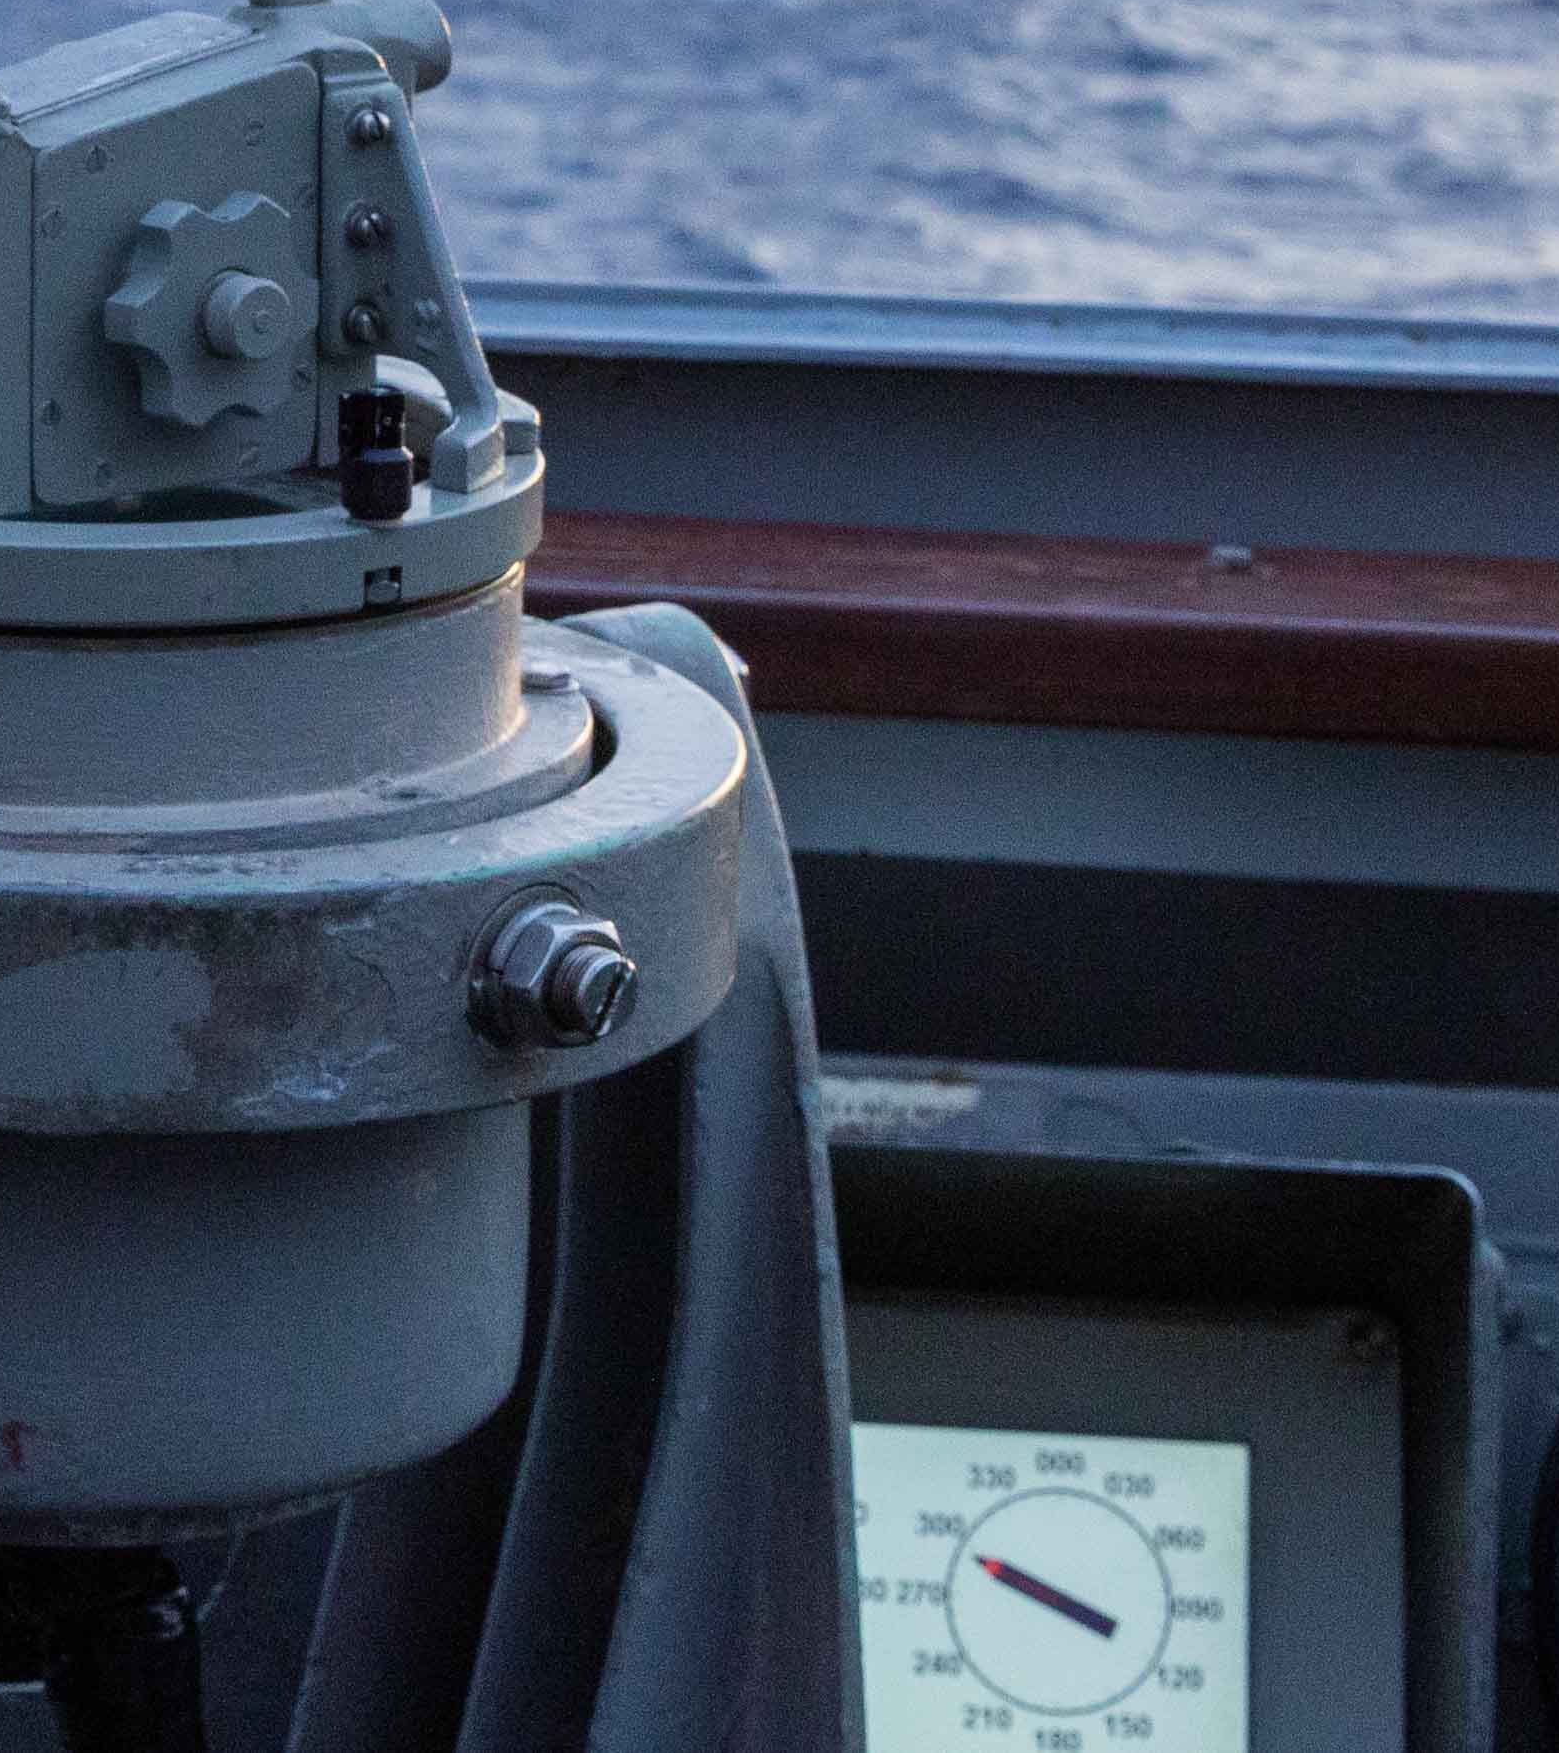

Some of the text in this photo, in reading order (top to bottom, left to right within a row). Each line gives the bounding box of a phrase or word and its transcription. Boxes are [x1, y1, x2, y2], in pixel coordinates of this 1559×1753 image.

[968, 1463, 1016, 1489] 330
[1035, 1451, 1085, 1476] 000
[1105, 1472, 1154, 1496] 030
[915, 1511, 963, 1536] 300
[897, 1579, 947, 1605] 270
[912, 1650, 961, 1676] 240
[1158, 1664, 1205, 1690] 120
[963, 1704, 1012, 1730] 210
[1106, 1713, 1153, 1739] 150
[1035, 1728, 1082, 1753] 180
